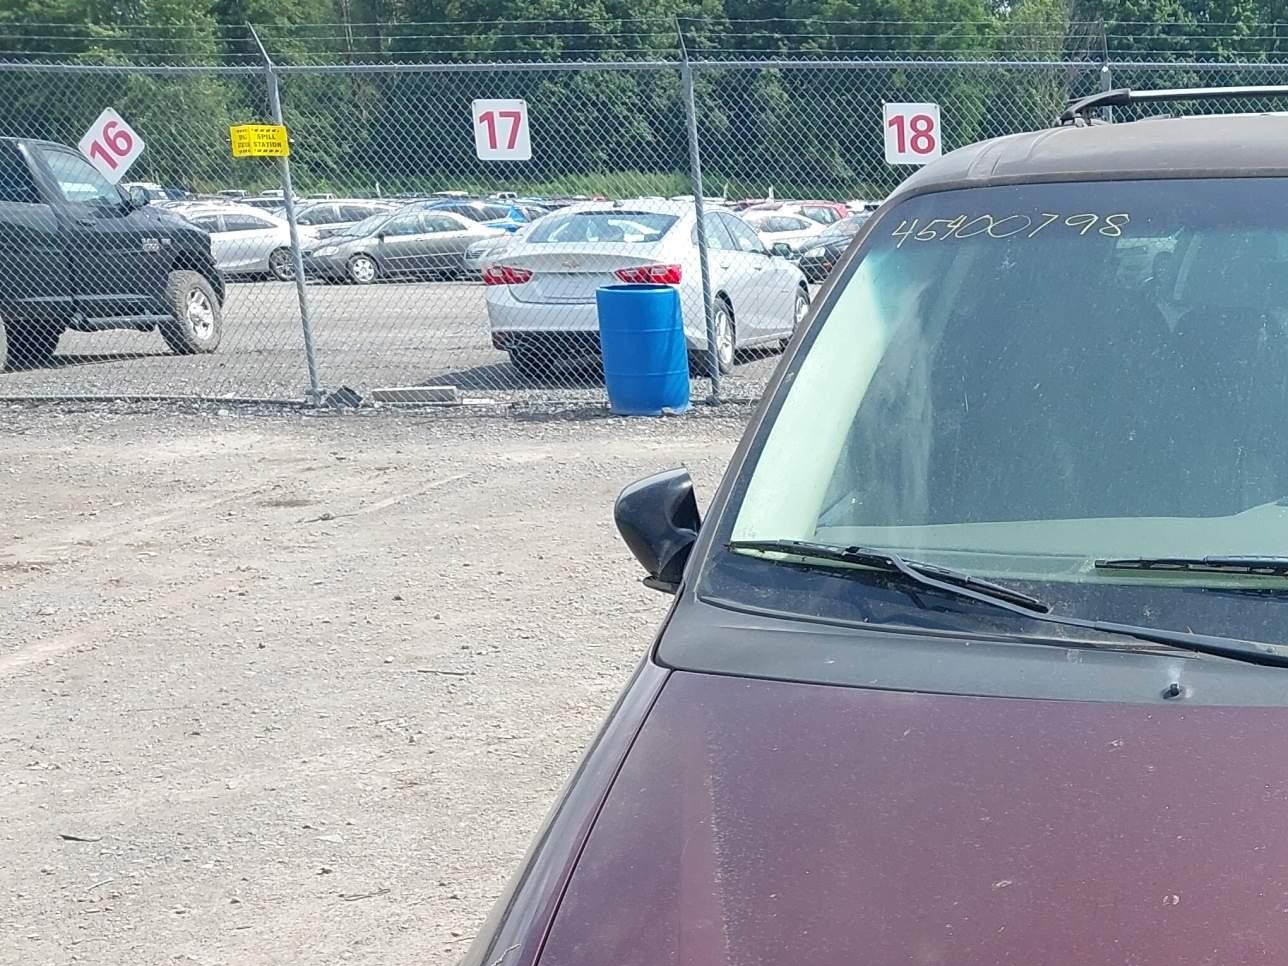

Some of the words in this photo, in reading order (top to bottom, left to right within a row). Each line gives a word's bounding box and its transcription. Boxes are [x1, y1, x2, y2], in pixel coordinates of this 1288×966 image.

[90, 121, 133, 170] 16
[479, 111, 521, 149] 17
[888, 114, 936, 154] 18
[892, 213, 1130, 248] 45400798
